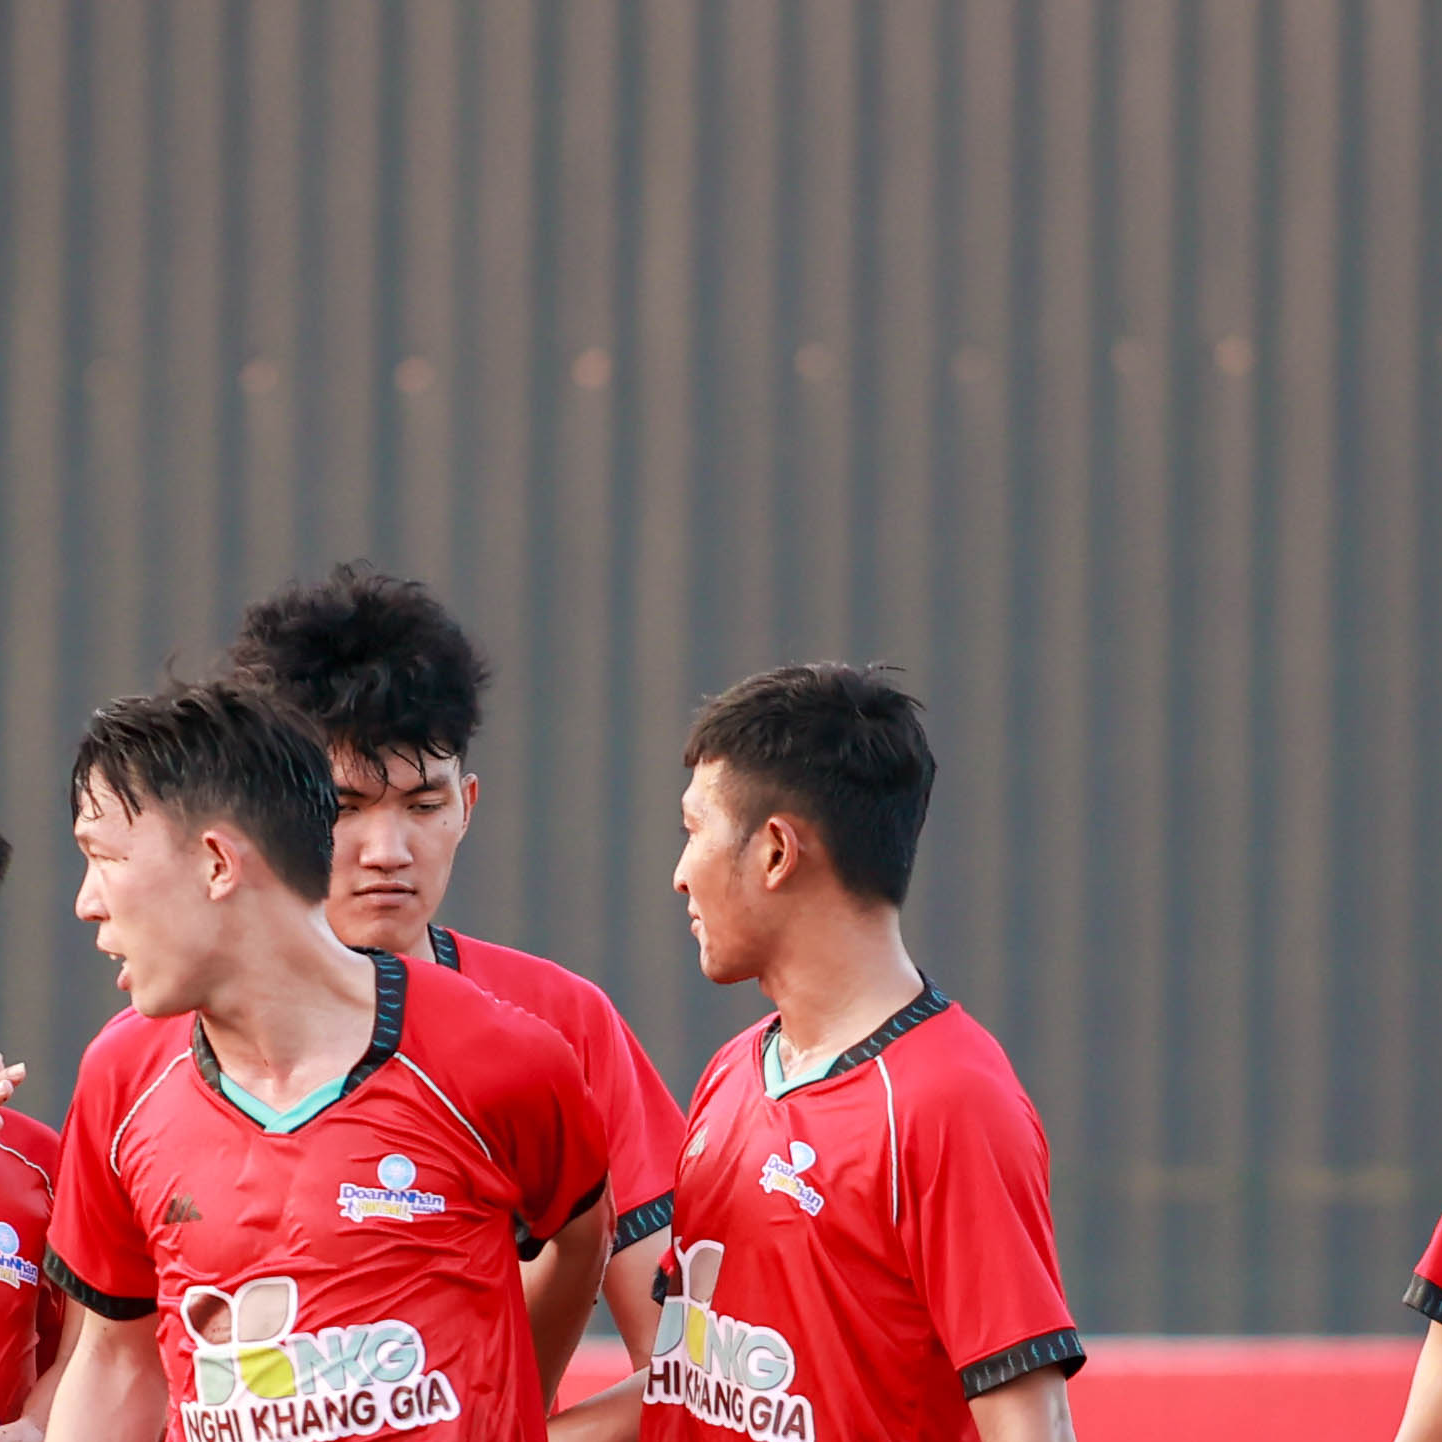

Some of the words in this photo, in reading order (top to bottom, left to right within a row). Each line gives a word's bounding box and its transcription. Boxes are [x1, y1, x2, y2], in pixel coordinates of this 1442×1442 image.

[293, 1327, 418, 1395] NKG
[704, 1316, 789, 1391] NKG
[250, 1389, 377, 1442] KHANG
[390, 1377, 451, 1421] GIA
[646, 1360, 681, 1396] HI
[685, 1365, 745, 1424] KHANG
[749, 1395, 807, 1441] GIA
